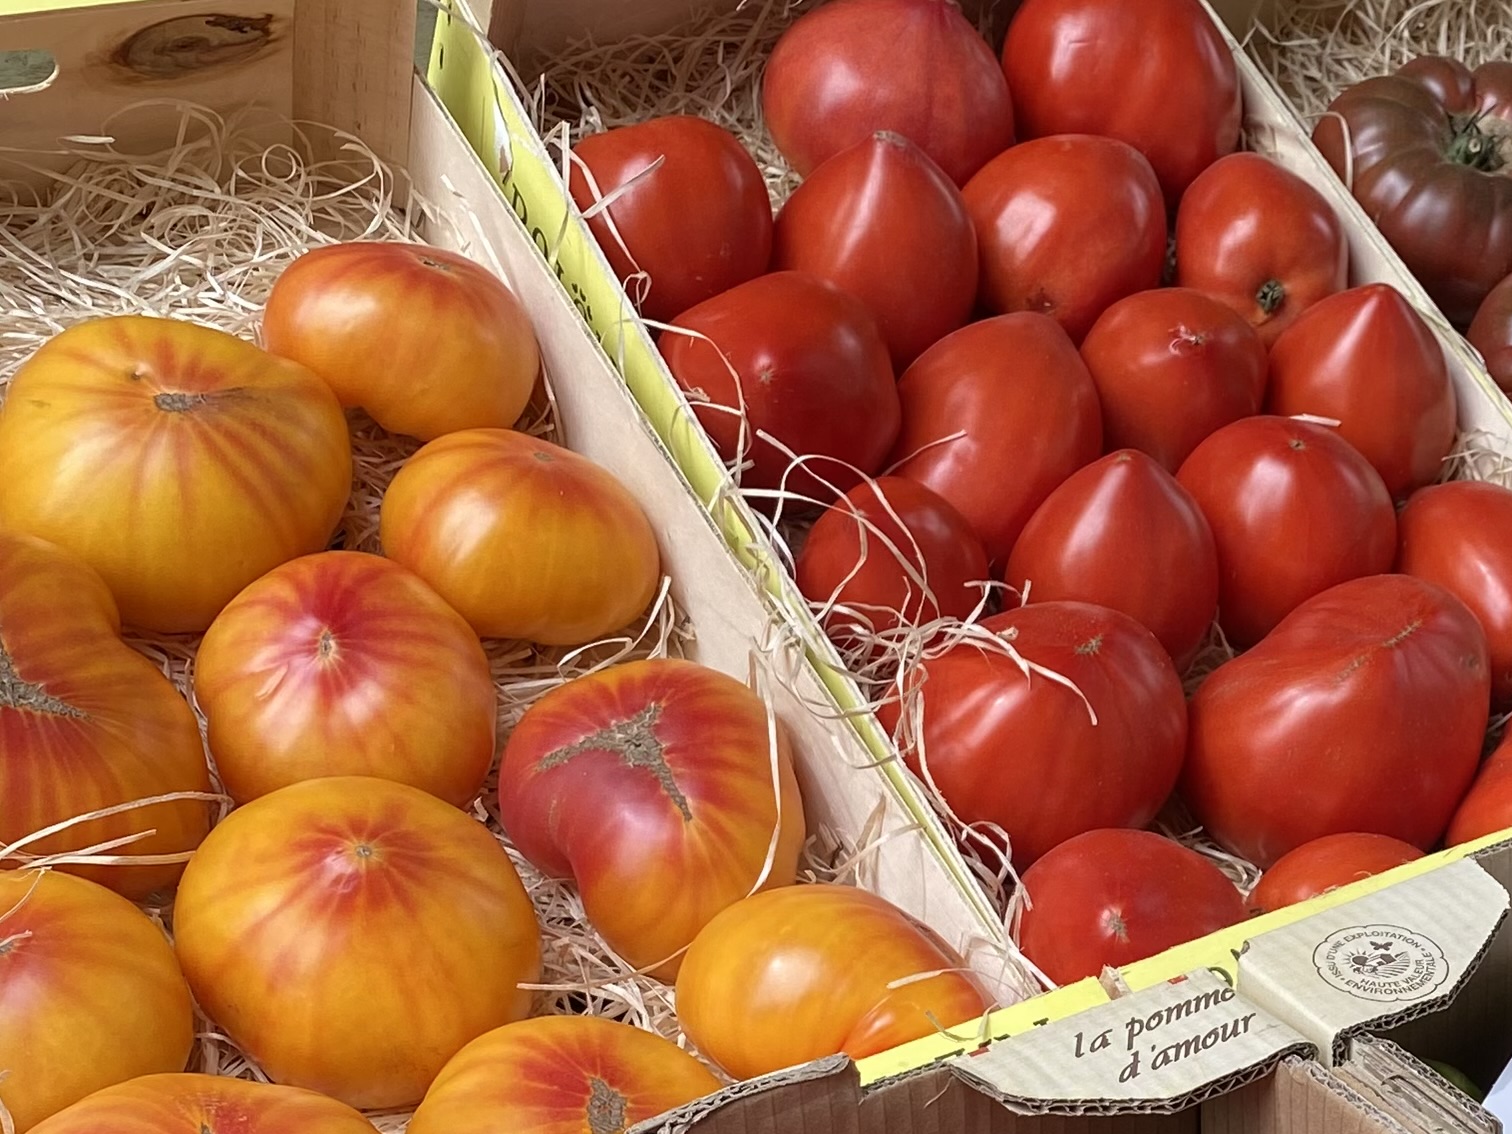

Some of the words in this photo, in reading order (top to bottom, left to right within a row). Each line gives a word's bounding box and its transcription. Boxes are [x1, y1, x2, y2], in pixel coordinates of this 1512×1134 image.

[1326, 940, 1345, 960] D'UNE
[1343, 931, 1422, 948] EXPLOITATION
[1327, 961, 1342, 978] ISSU
[1345, 951, 1437, 995] ENVIRONNEMENTALE
[1360, 978, 1401, 988] HAUTE
[1402, 959, 1425, 985] VALEUR
[1074, 1028, 1113, 1058] la
[1125, 987, 1236, 1051] pomme
[1118, 1013, 1256, 1083] d'amour
